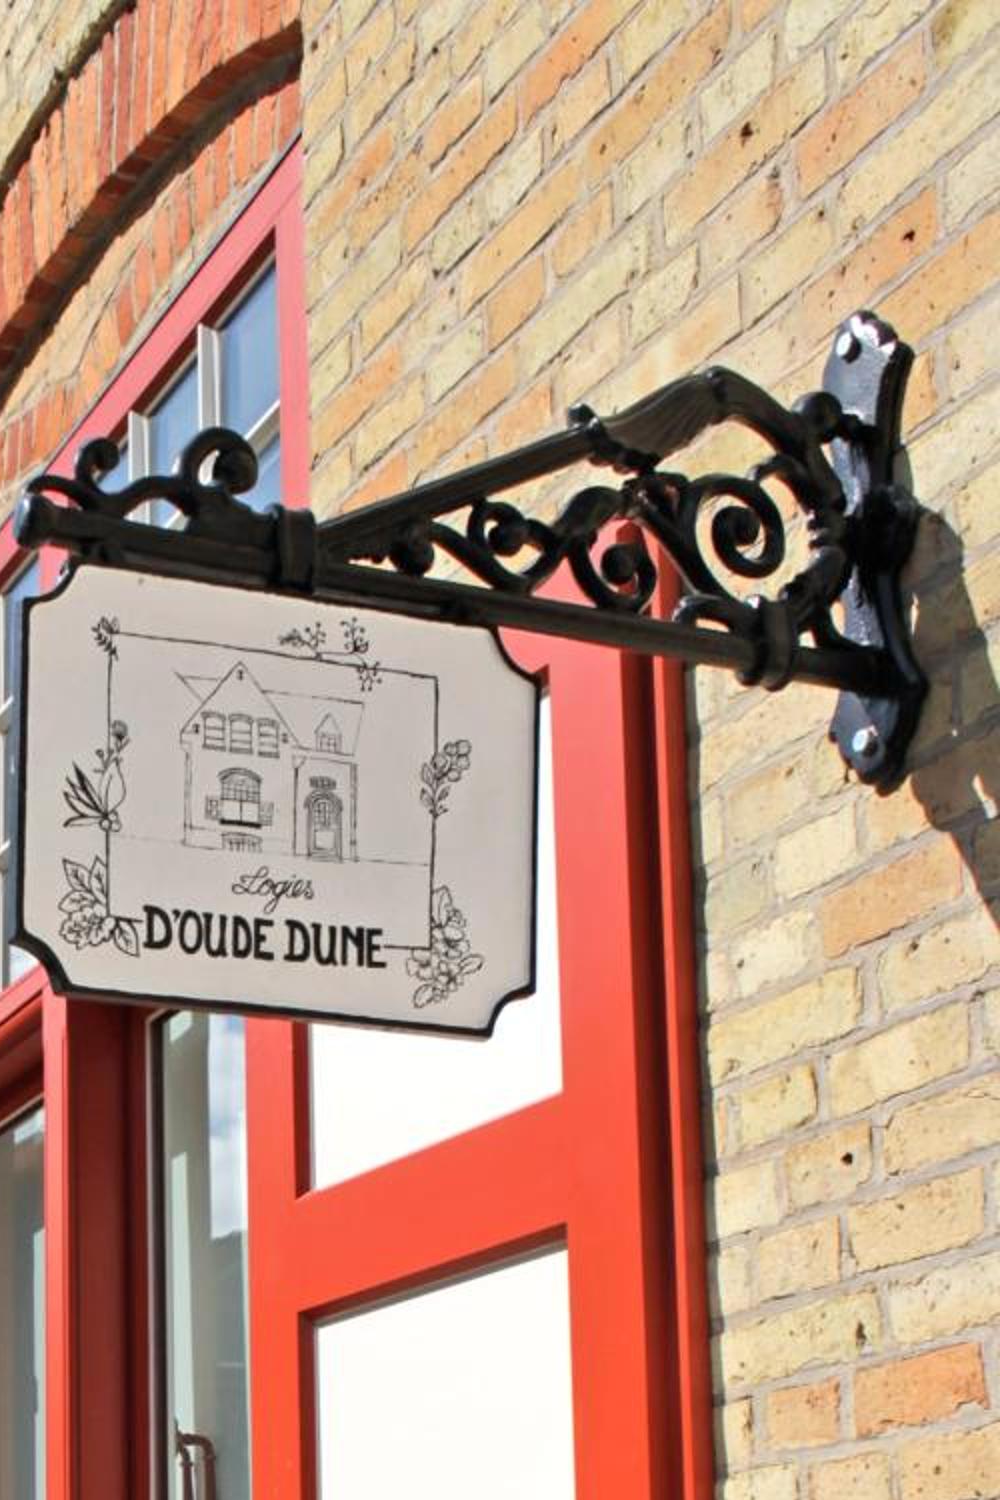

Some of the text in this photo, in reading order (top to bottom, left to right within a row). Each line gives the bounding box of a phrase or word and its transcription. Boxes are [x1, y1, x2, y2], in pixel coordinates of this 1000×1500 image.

[232, 866, 314, 914] Logies
[143, 905, 387, 968] D'OUDE DUNE
